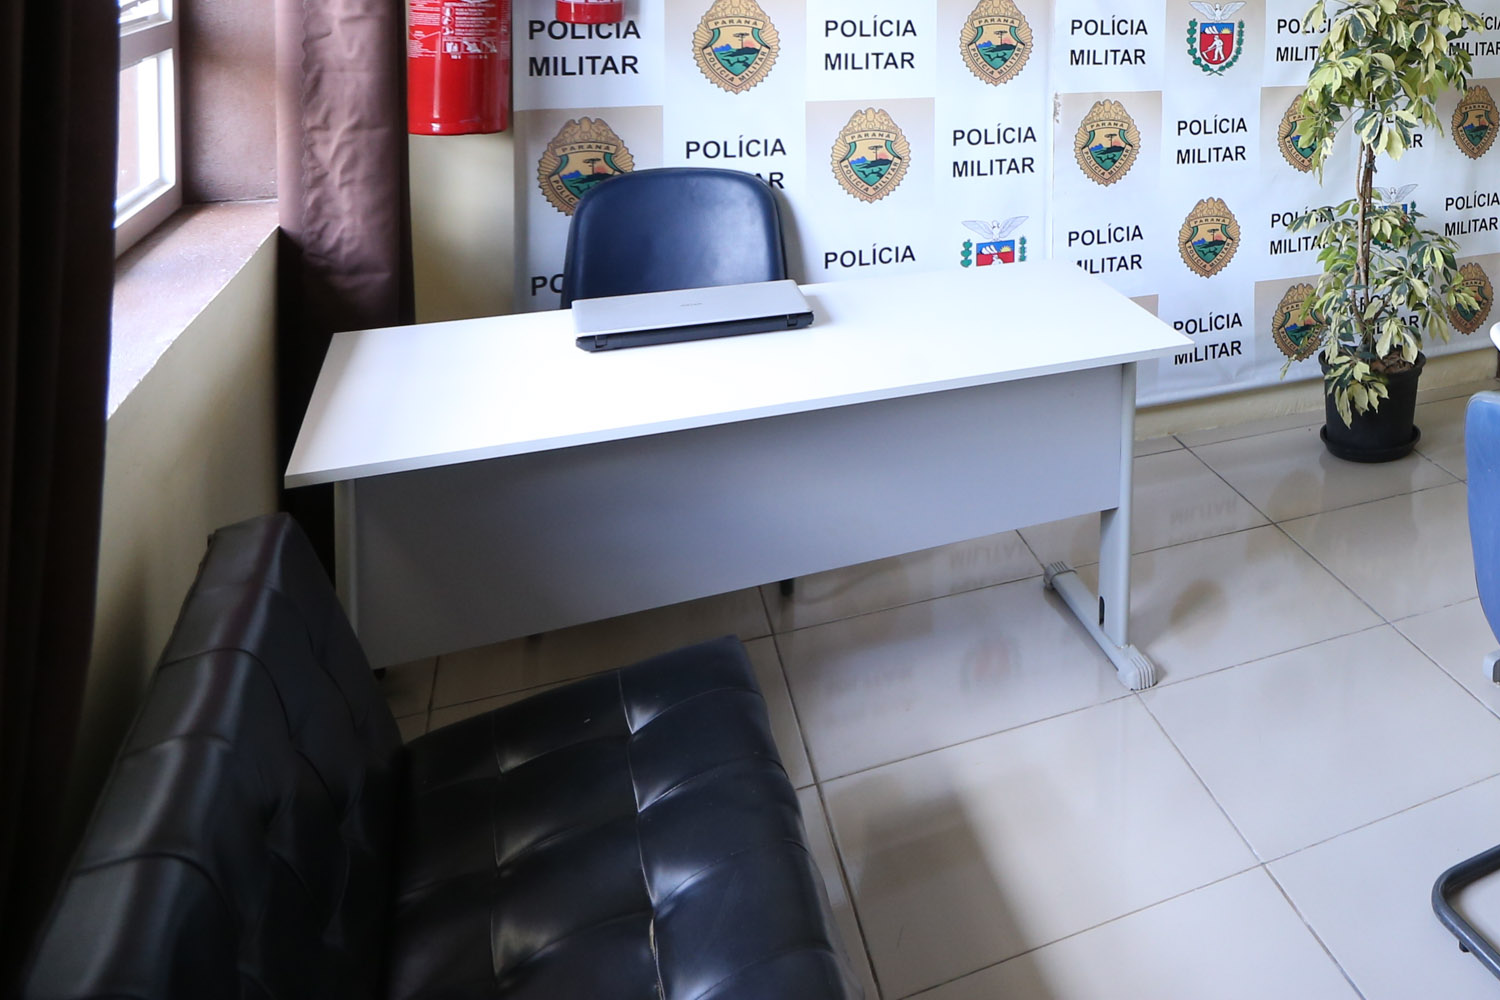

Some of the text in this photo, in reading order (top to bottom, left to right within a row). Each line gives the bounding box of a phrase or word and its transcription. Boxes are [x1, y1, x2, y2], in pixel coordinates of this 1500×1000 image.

[824, 15, 917, 38] POLÍCIA
[1071, 15, 1148, 36] POLÍCIA
[824, 51, 915, 71] MILITAR
[1070, 48, 1146, 66] MILITAR
[1276, 46, 1319, 61] MILIT
[528, 55, 639, 77] MILITAR
[952, 123, 1037, 147] POLÍCIA
[1177, 114, 1248, 136] POLÍCIA
[685, 134, 787, 160] POLÍCIA
[1176, 145, 1246, 165] MILITAR
[952, 156, 1035, 178] MILITAR
[1445, 191, 1500, 212] POLÍCIA
[1067, 223, 1144, 247] POLÍCIA
[1444, 216, 1499, 237] MILITAR
[1270, 234, 1326, 255] MILITA
[824, 243, 916, 270] POLÍCIA
[1173, 312, 1243, 336] POLÍCIA
[1174, 340, 1242, 365] MILITAR
